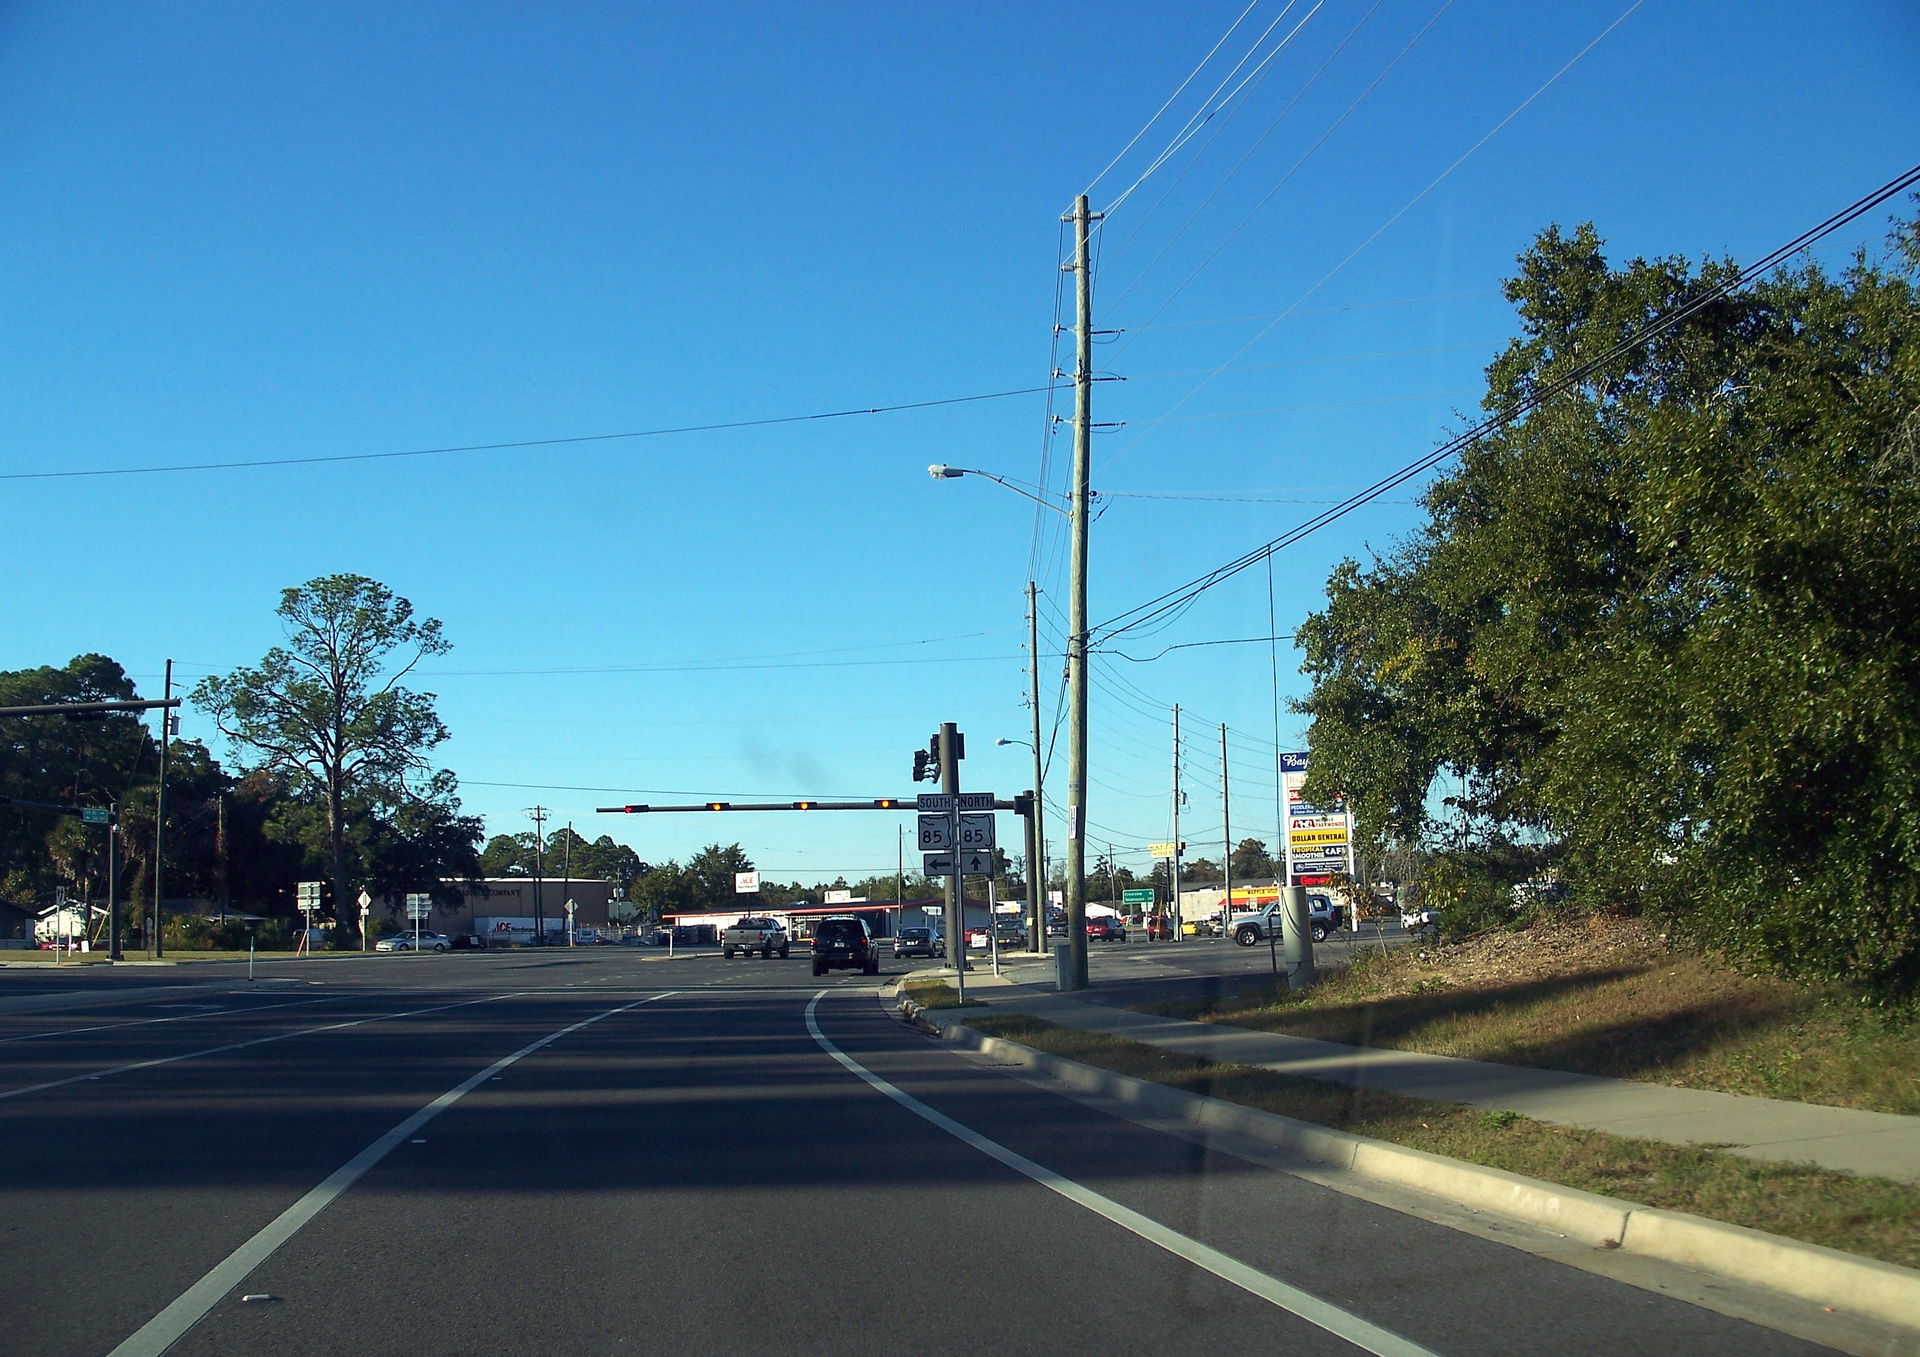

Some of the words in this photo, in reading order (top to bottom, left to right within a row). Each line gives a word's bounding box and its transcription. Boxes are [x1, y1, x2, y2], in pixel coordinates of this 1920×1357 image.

[919, 797, 951, 808] SOUTH
[960, 796, 993, 807] NORTH
[922, 830, 942, 843] 85
[963, 829, 983, 842] 85
[1317, 833, 1346, 841] GENERAL
[494, 921, 512, 932] ACE
